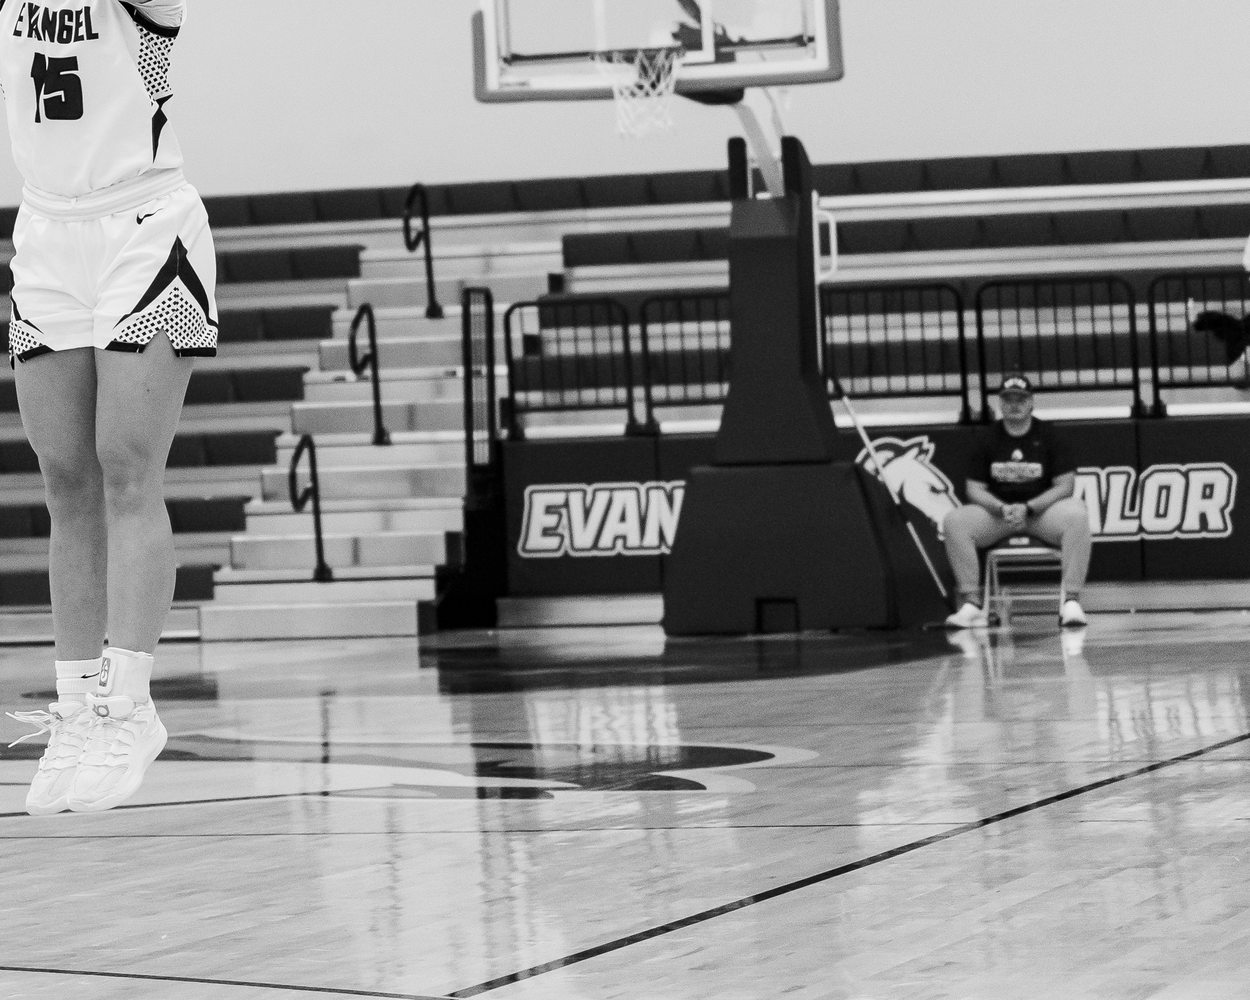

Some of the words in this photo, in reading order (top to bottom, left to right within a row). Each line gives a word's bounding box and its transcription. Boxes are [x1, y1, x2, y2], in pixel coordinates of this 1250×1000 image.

[30, 52, 84, 124] 15
[520, 483, 685, 555] EVAN
[1072, 465, 1234, 539] ALOR
